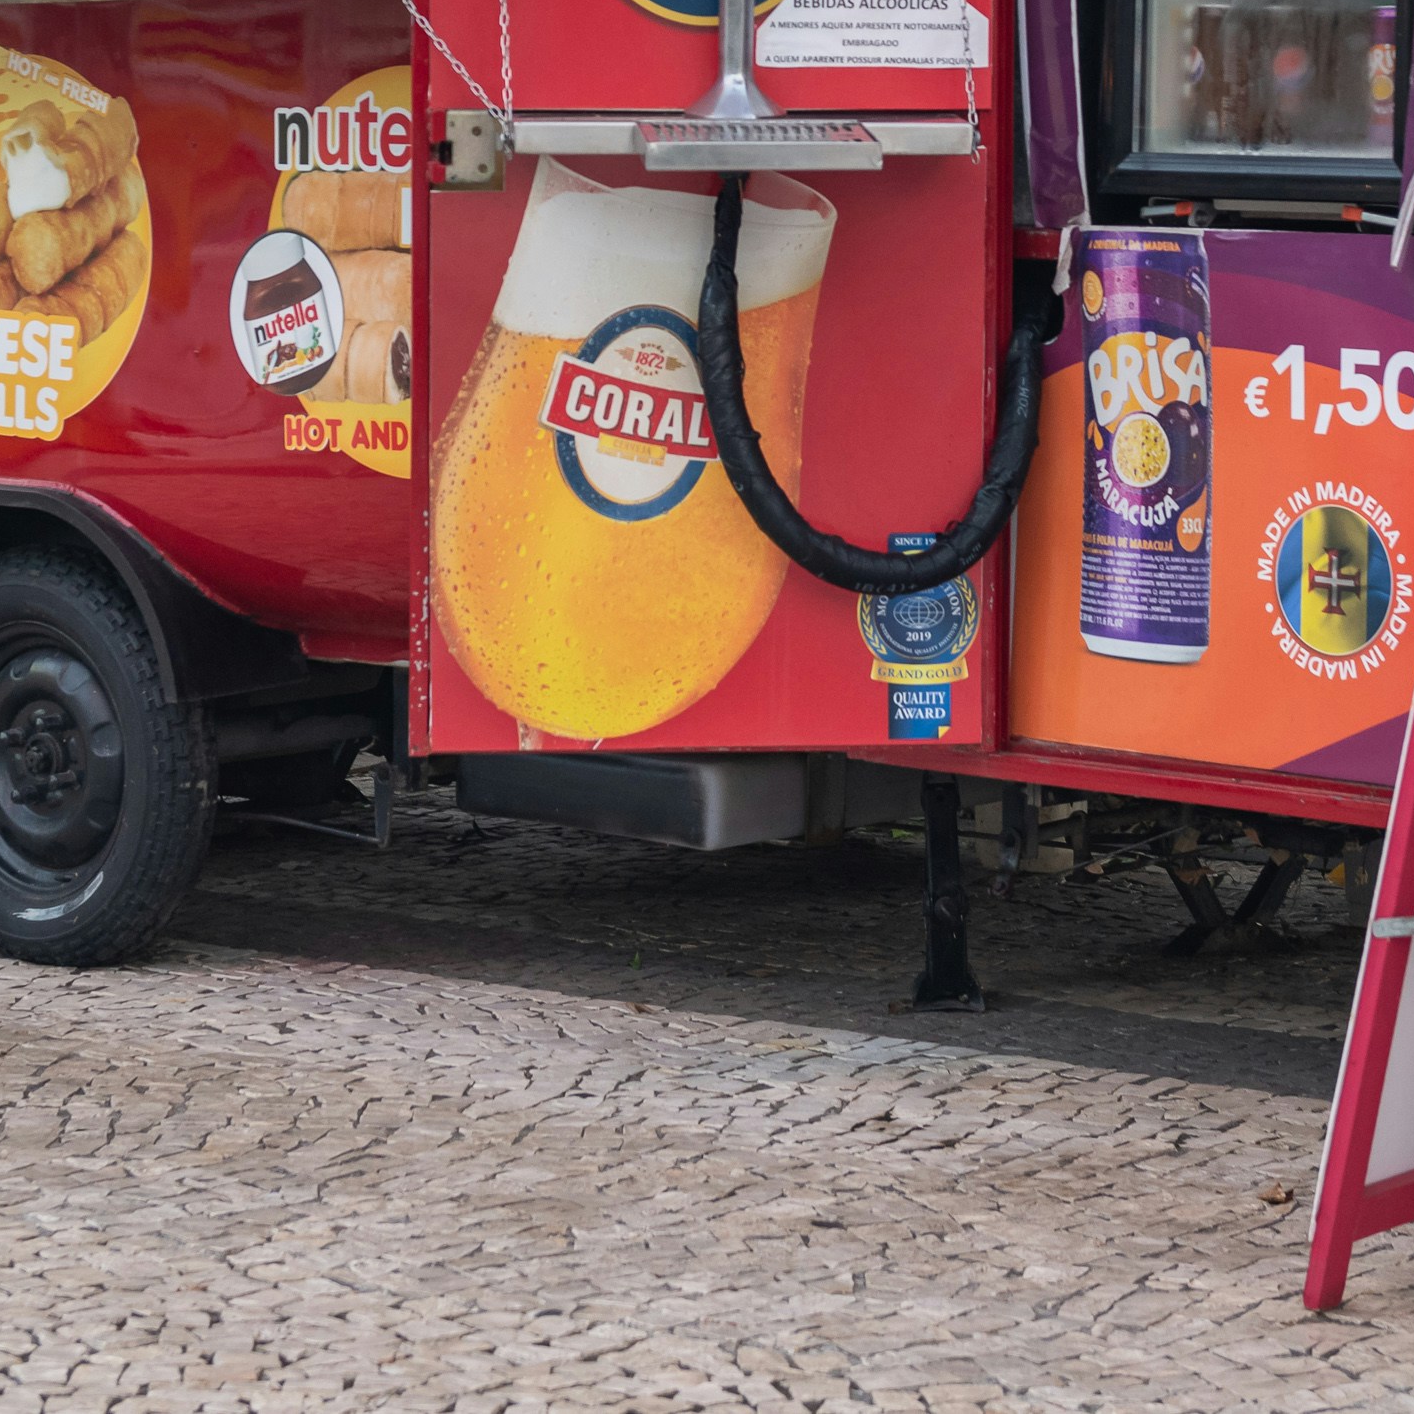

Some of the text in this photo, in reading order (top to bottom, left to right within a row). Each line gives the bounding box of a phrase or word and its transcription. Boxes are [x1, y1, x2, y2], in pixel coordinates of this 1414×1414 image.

[778, 21, 819, 29] MENORES
[821, 21, 853, 30] AQUEM
[856, 22, 901, 30] APRESENTE
[842, 39, 899, 47] EMBRIAGADO
[773, 55, 800, 63] QUEM
[802, 56, 844, 64] APARENTE
[847, 56, 882, 64] POSSUIR
[884, 57, 934, 65] ANOMALIAS
[6, 50, 42, 82] HOT
[61, 77, 109, 116] FRESH
[277, 96, 412, 168] nute
[1143, 241, 1181, 252] MADEIRA
[254, 301, 319, 344] nutella
[636, 350, 666, 370] 1872
[565, 374, 710, 447] CORAL
[286, 417, 409, 452] HOT AND
[1095, 458, 1180, 528] MARACUJÁ
[1181, 517, 1204, 534] 33CL
[1257, 480, 1401, 582] MADE IN MADEIRA
[894, 537, 923, 546] SINCE
[1271, 573, 1413, 681] MADE IN MADEIRA
[905, 631, 932, 642] 2019
[877, 666, 962, 679] GRAND GOLD
[893, 691, 946, 708] QUALITY
[894, 707, 946, 720] AWARD
